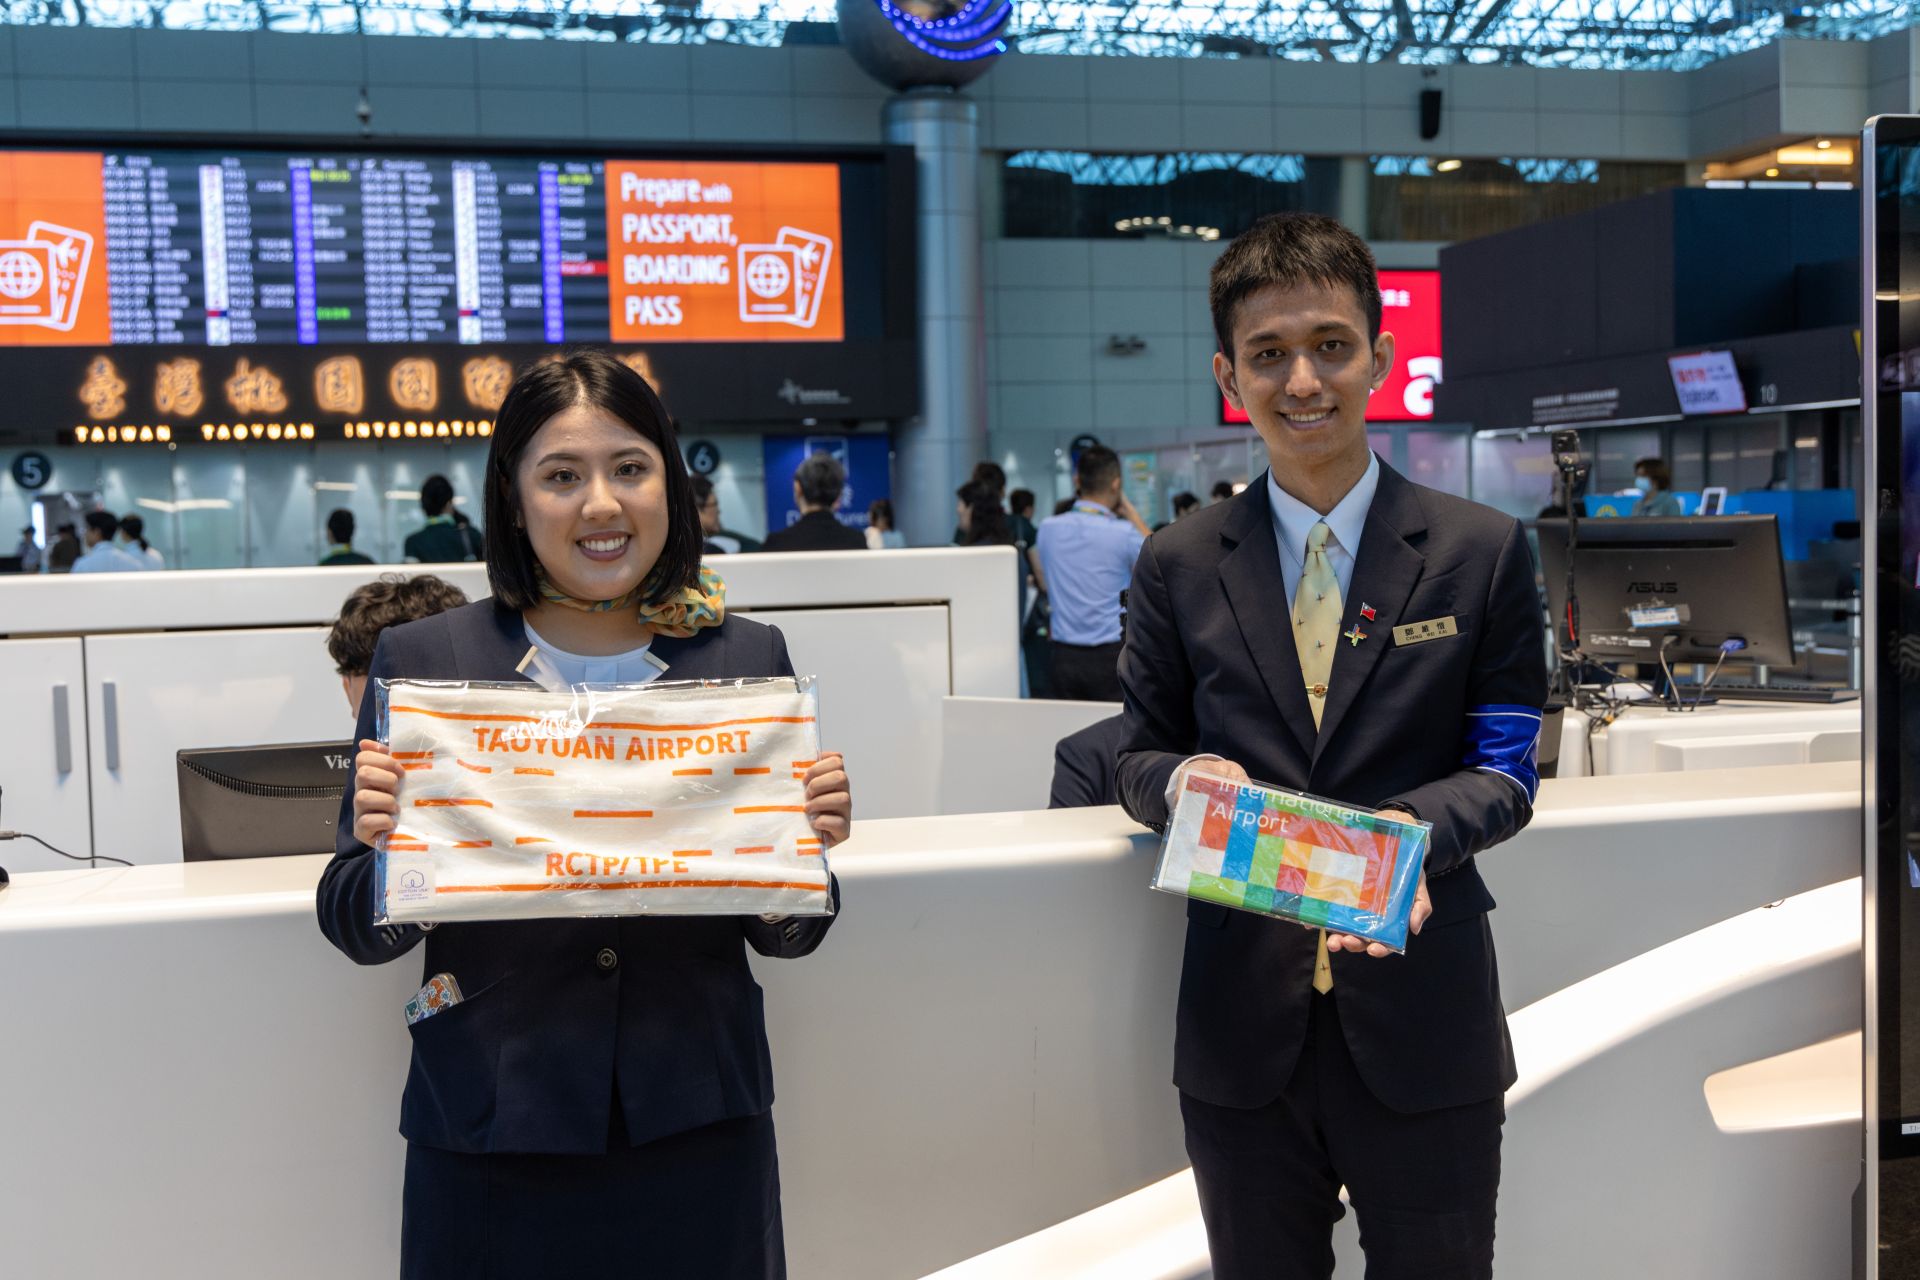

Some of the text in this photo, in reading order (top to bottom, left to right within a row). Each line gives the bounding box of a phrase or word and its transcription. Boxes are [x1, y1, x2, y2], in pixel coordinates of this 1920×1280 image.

[620, 172, 732, 207] Prepare with
[622, 214, 738, 247] PASSPORT,
[624, 254, 730, 285] BOARDING
[625, 296, 683, 326] PASS
[75, 425, 171, 443] TAIWAN
[202, 423, 315, 441] TAOYUAN
[22, 457, 43, 486] 5
[694, 446, 712, 470] 6
[1627, 582, 1679, 594] ASUS
[473, 725, 751, 762] TAOYUAN AIRPORT
[324, 755, 351, 769] Vie
[1212, 802, 1289, 834] Airport
